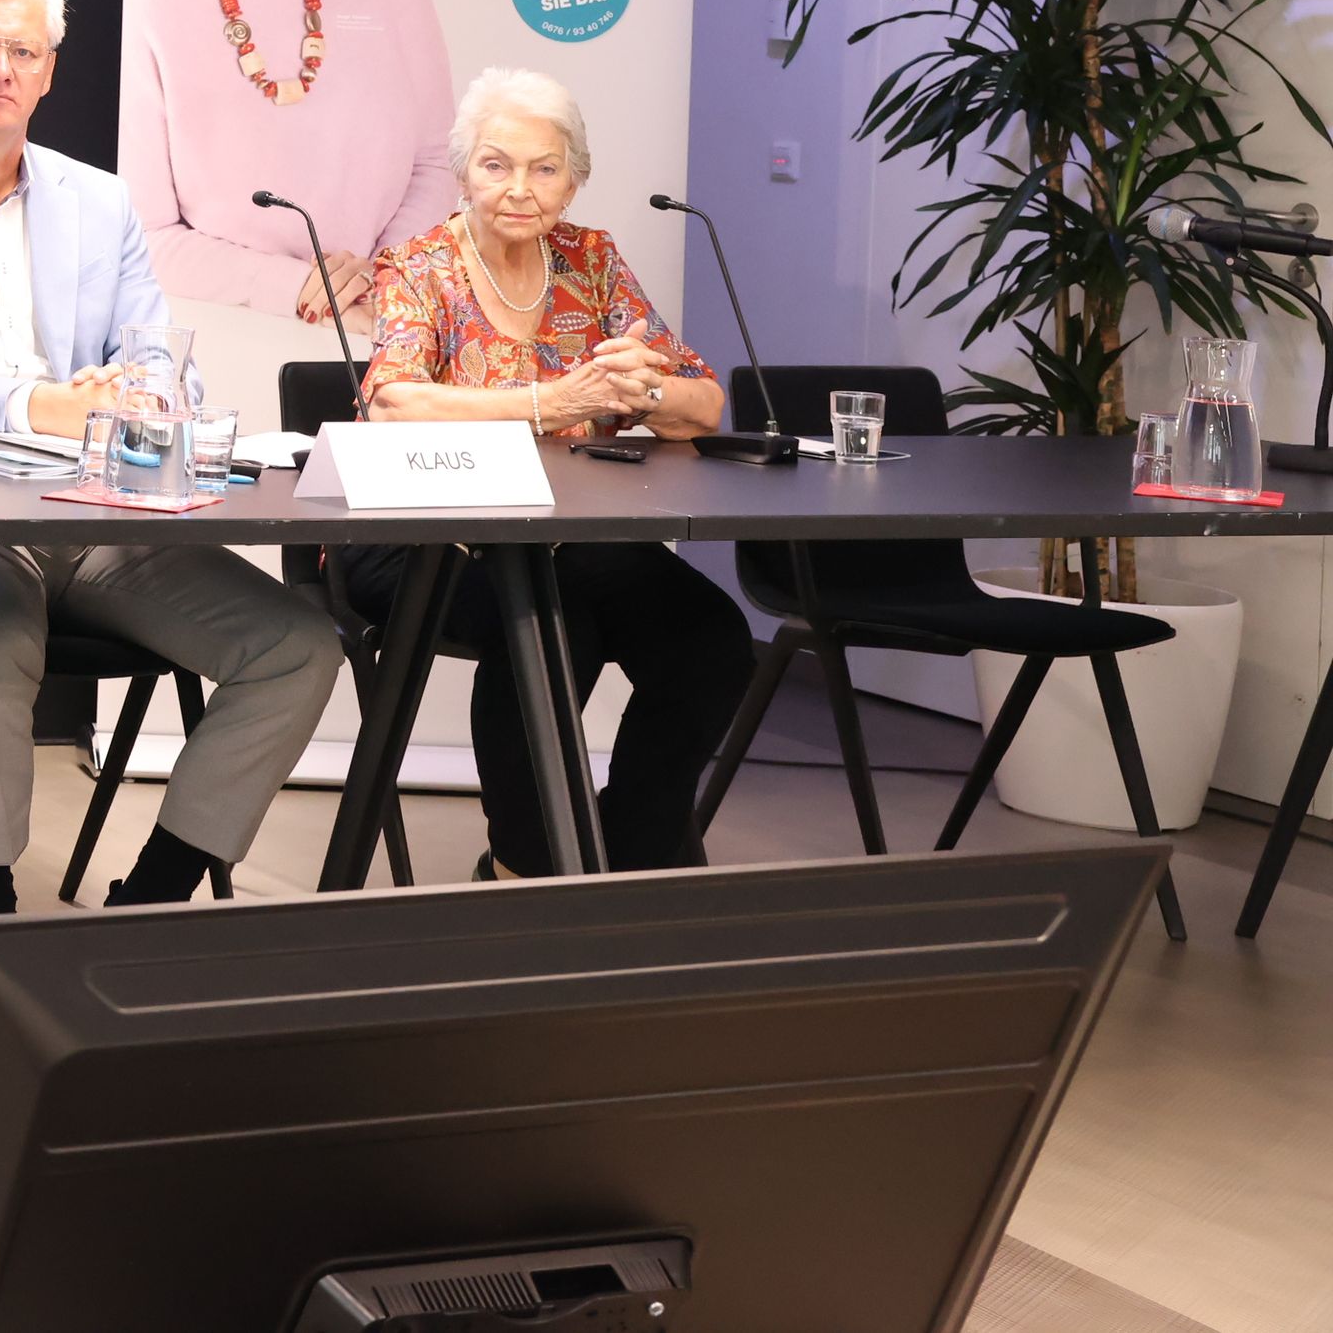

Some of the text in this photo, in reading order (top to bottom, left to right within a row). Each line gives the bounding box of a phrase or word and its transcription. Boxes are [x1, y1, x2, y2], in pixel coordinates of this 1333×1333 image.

[542, 21, 564, 36] 0676
[573, 26, 586, 36] 93
[587, 22, 599, 32] 40
[599, 10, 614, 26] 746
[406, 452, 476, 471] KLAUS
